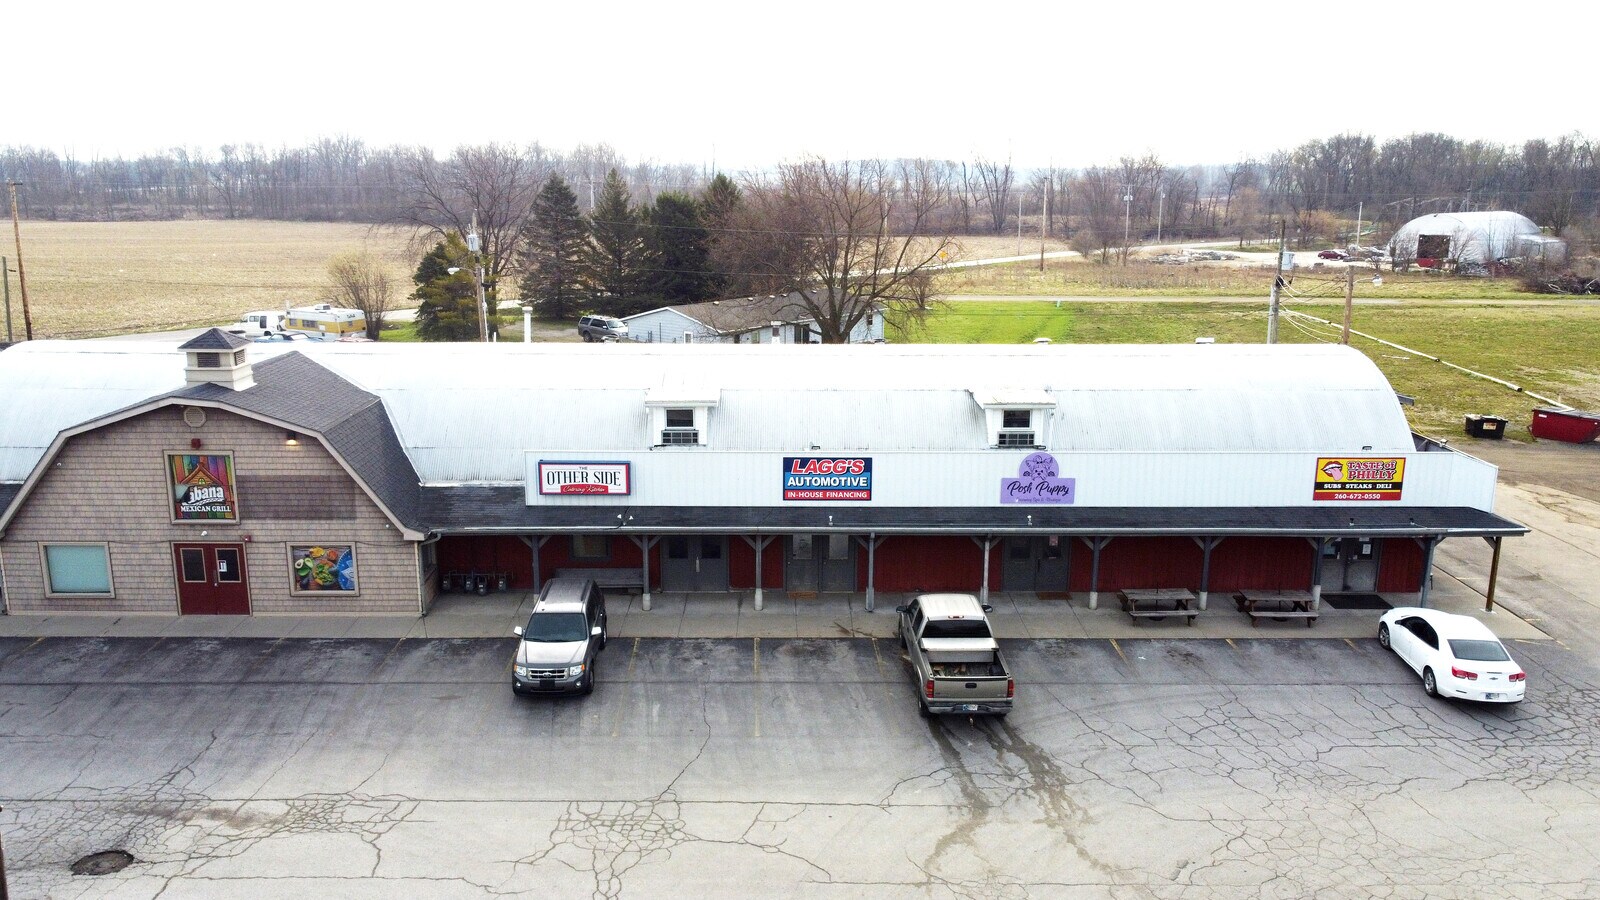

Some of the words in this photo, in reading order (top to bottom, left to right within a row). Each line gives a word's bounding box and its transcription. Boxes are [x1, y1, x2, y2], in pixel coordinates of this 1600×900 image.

[791, 459, 865, 474] LAGG'S
[1347, 461, 1383, 470] TASTE
[1384, 460, 1397, 470] of
[546, 471, 589, 486] OTHER
[593, 471, 621, 486] SIDE
[787, 476, 868, 487] AUTOMOTIVE
[1347, 470, 1396, 480] PHILLY
[1007, 481, 1033, 496] Posh
[1035, 481, 1070, 496] Puppy
